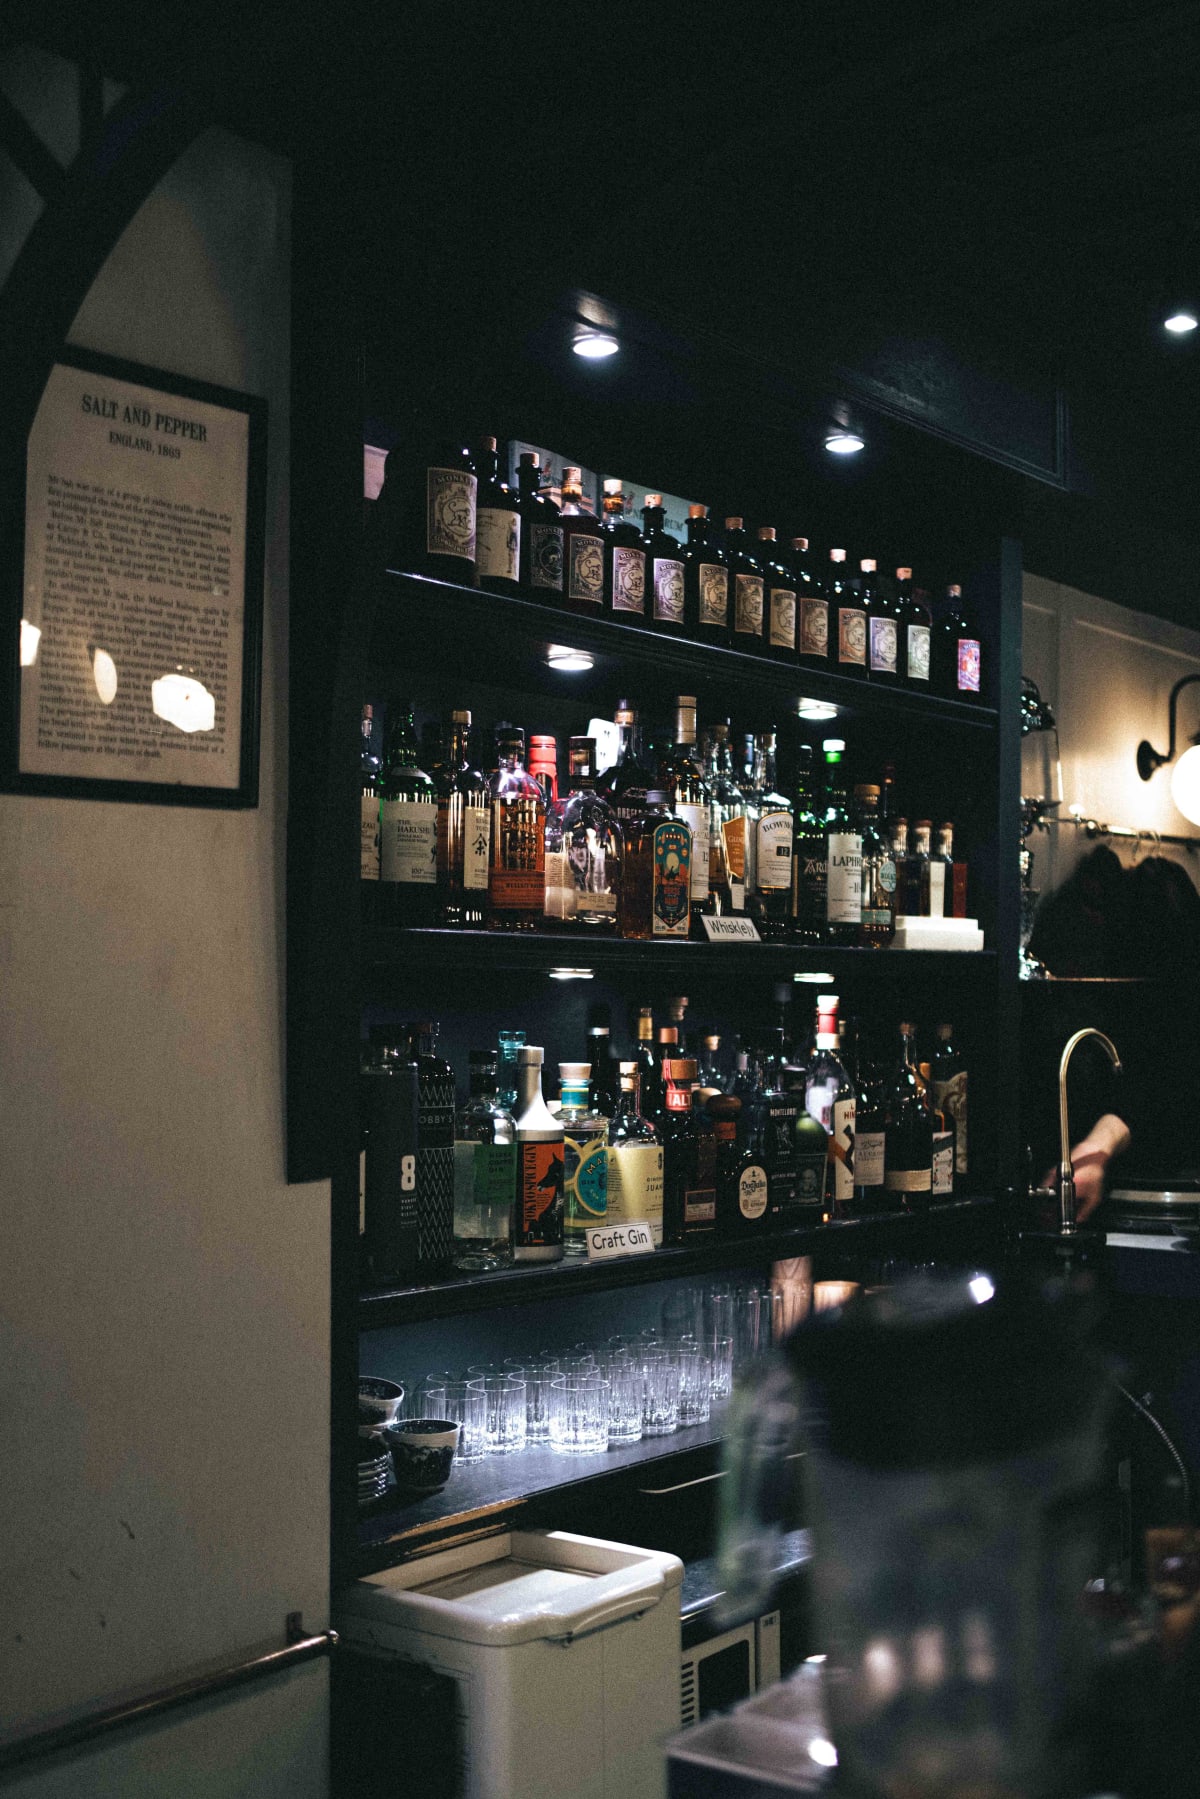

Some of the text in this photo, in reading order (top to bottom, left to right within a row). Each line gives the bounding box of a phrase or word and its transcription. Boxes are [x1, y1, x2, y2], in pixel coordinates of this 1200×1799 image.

[82, 394, 207, 442] SALT AND PEPPER
[109, 431, 155, 455] ENGLAND,
[709, 918, 755, 938] Whisk(e)y
[418, 1115, 453, 1125] OBBY'S
[401, 1154, 416, 1191] 8
[592, 1229, 648, 1250] Craft Gin
